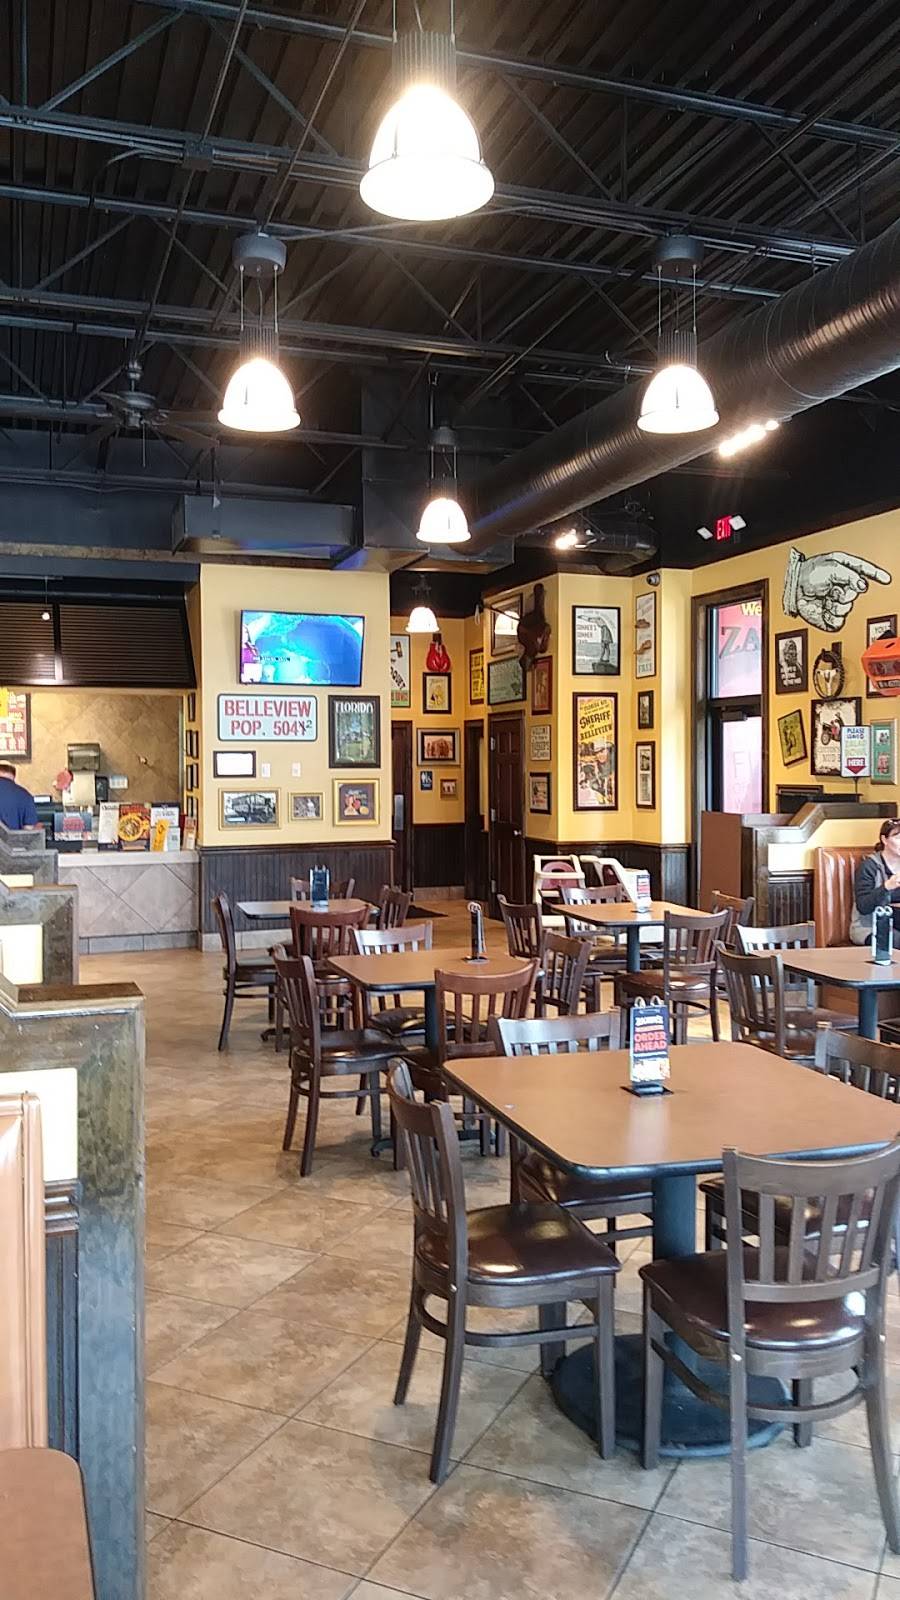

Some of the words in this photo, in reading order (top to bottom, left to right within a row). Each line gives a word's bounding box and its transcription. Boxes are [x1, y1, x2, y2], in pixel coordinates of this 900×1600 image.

[717, 516, 732, 540] EXIT
[224, 699, 311, 717] BELLEVIEW
[335, 701, 374, 713] FLORIDA
[579, 710, 611, 729] SHERIFF
[231, 720, 266, 736] POP.
[848, 758, 865, 767] HERE
[634, 1031, 666, 1042] ORDER
[634, 1041, 667, 1052] AHEAD
